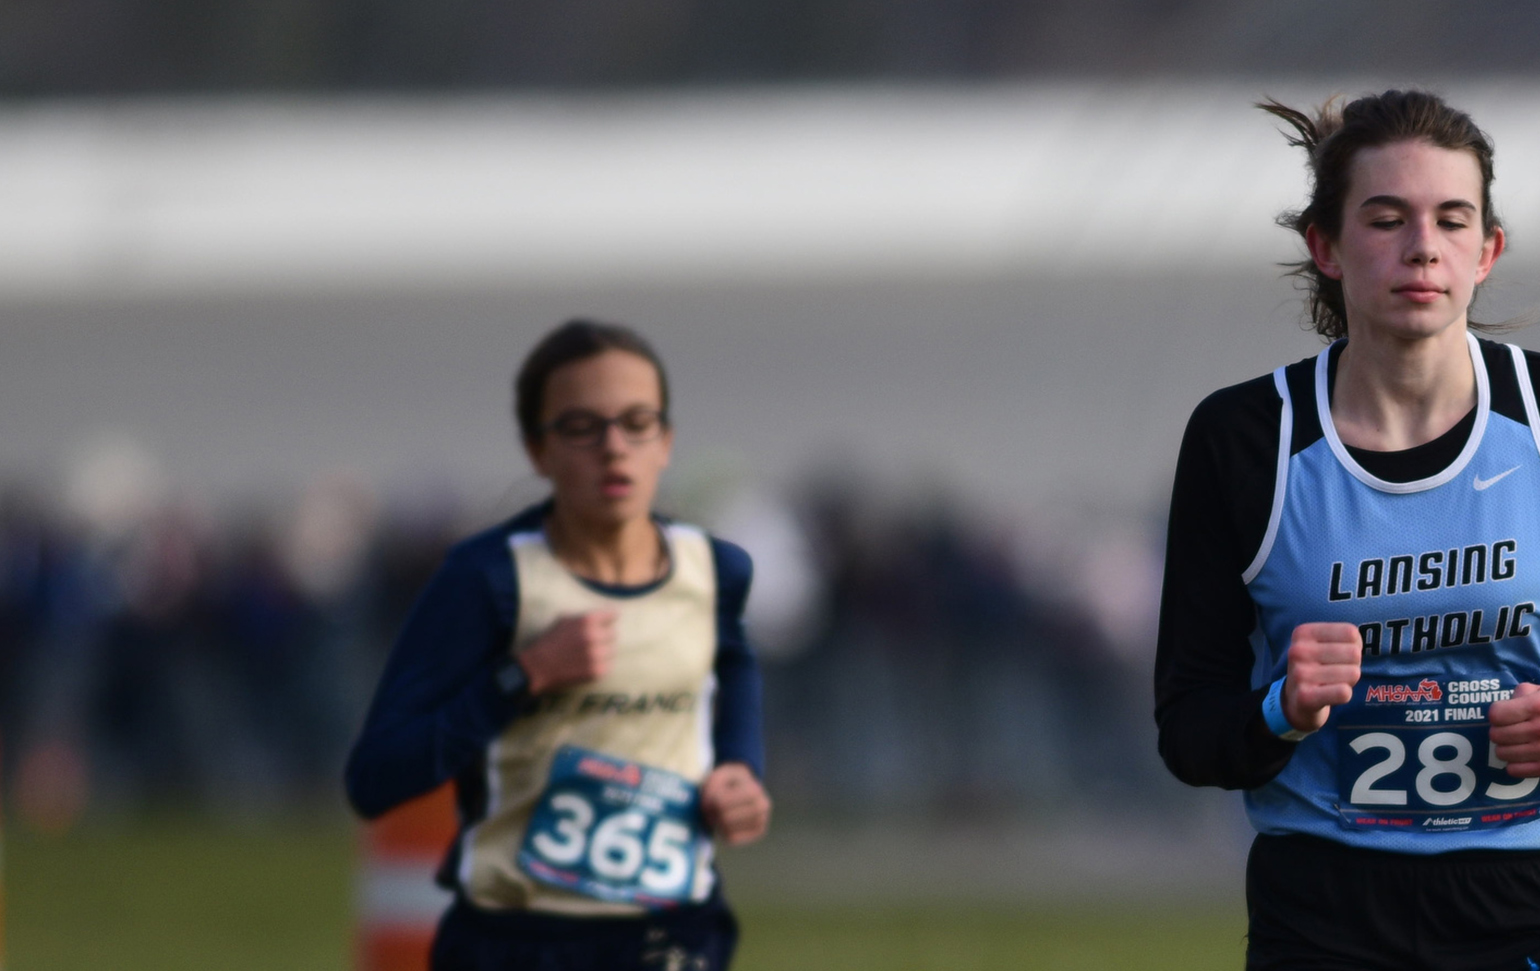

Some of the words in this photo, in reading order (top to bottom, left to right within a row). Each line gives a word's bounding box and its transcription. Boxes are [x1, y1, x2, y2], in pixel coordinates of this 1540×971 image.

[1328, 538, 1518, 602] LANSING
[1358, 602, 1535, 656] ATHOLIC
[1448, 679, 1499, 693] CROSS
[1405, 709, 1439, 722] 2021
[1445, 707, 1485, 721] FINAL
[532, 792, 690, 892] 365
